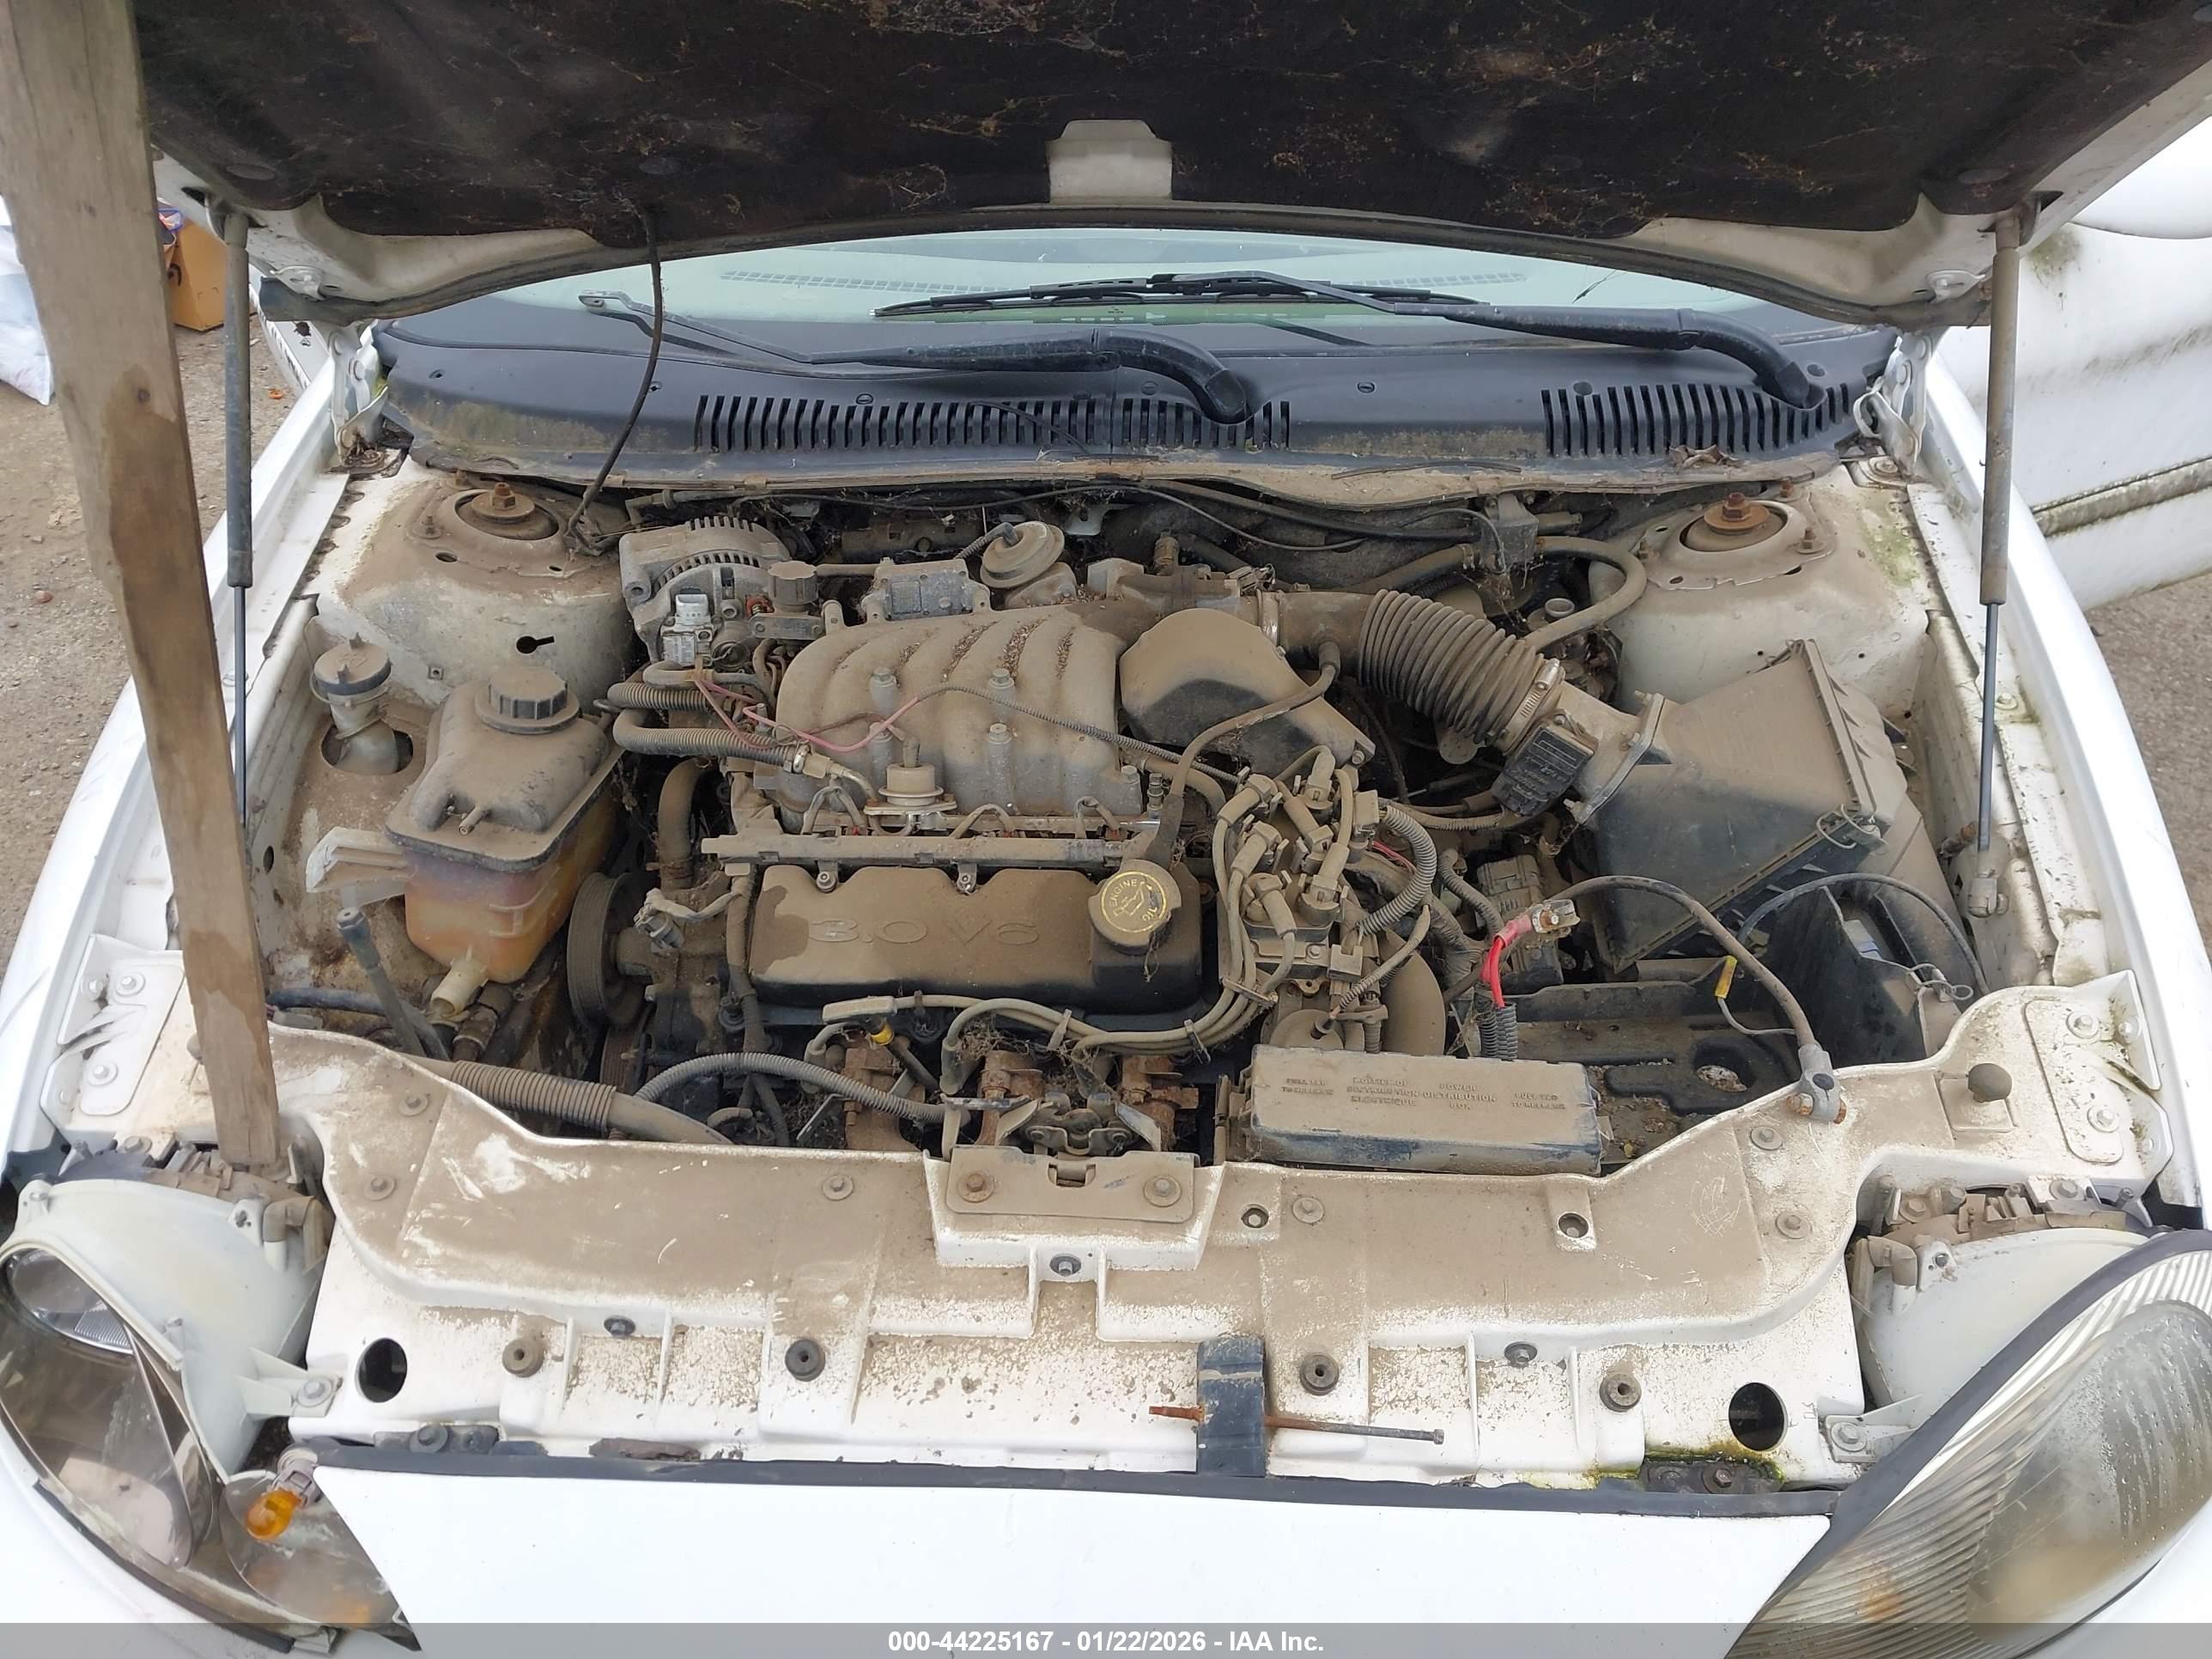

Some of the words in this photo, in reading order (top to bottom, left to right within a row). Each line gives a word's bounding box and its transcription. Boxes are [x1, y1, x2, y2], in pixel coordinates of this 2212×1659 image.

[1109, 878, 1138, 908] ENGINE
[1142, 907, 1158, 921] OIL
[1422, 1091, 1497, 1103] DISTRIBUTION
